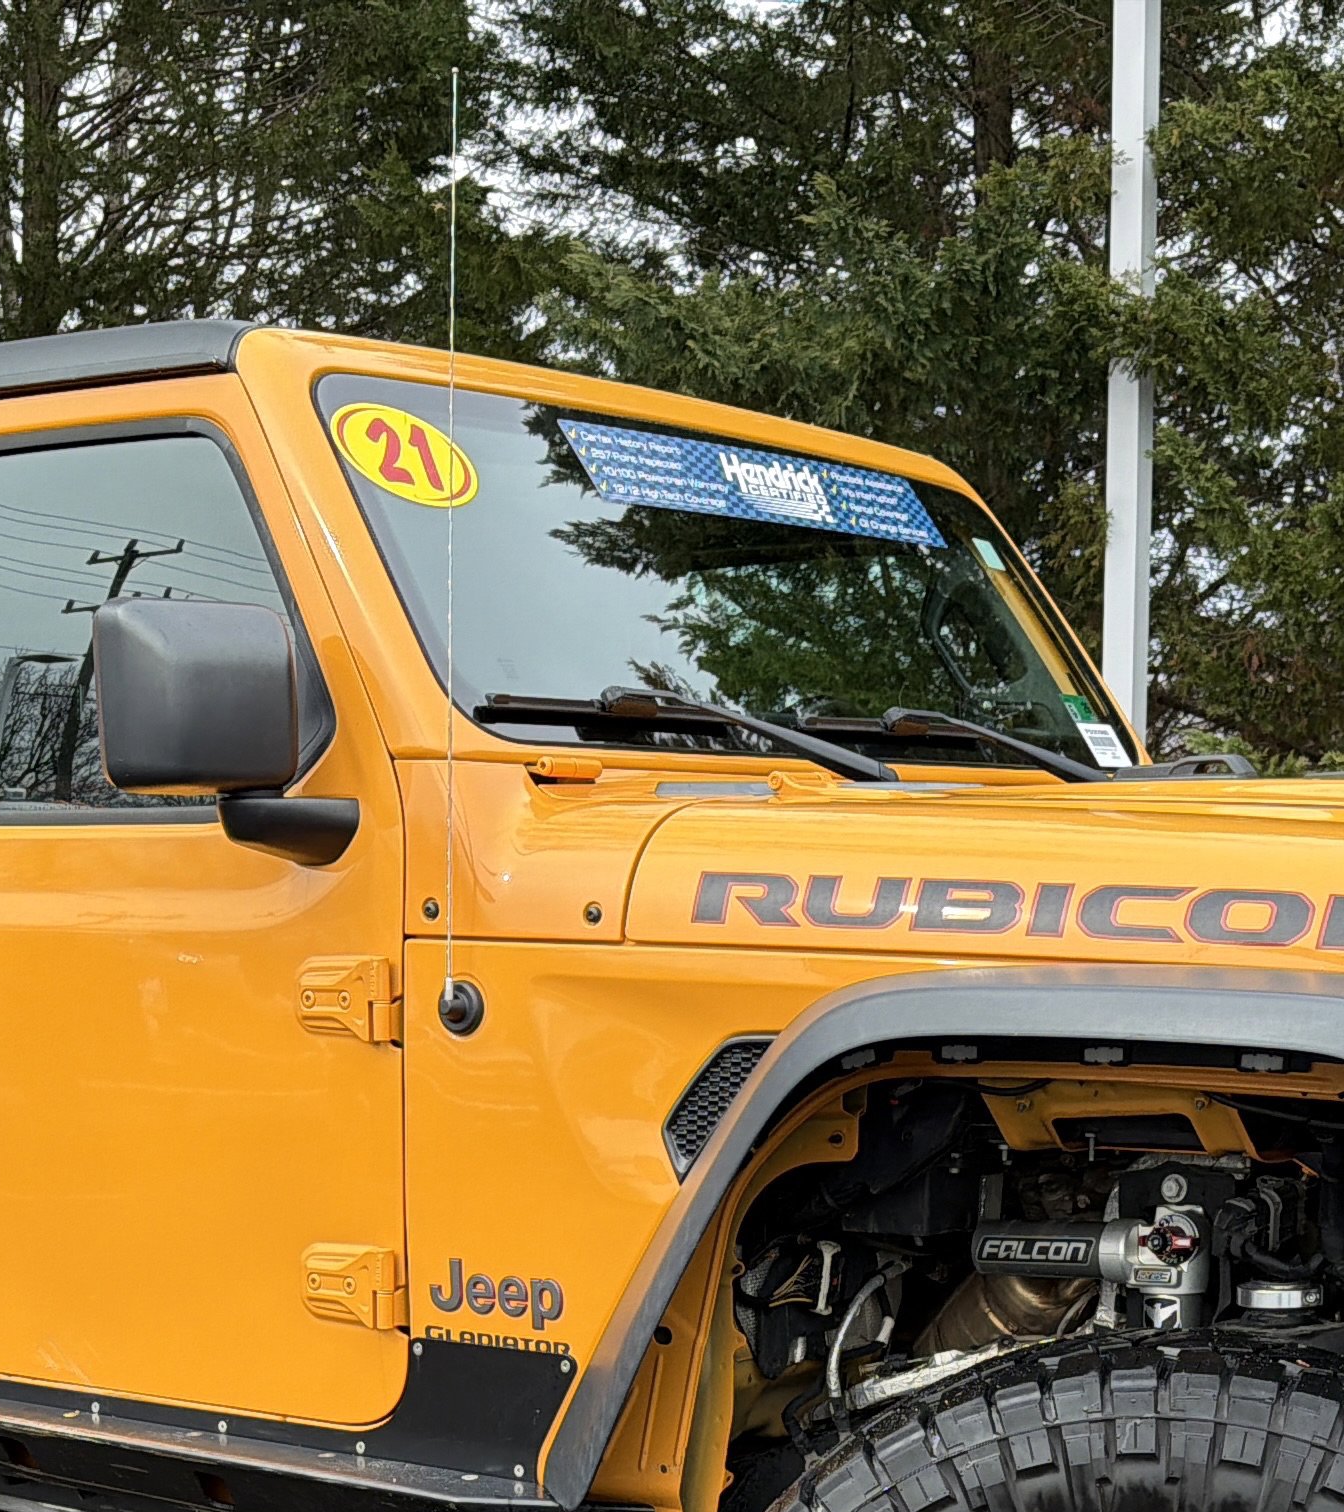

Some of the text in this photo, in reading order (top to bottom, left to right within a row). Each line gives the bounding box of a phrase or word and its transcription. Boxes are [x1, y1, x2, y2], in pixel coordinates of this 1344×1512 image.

[365, 417, 445, 492] 21
[615, 437, 648, 451] History
[649, 441, 682, 456] Report
[602, 465, 637, 480] 10/100
[718, 451, 825, 495] Hendrick
[612, 483, 641, 496] 12/12
[747, 483, 828, 505] CERTIFIED
[981, 1238, 1088, 1262] FALCON
[429, 1257, 565, 1331] Jeep
[424, 1325, 571, 1356] GLADIATOR
